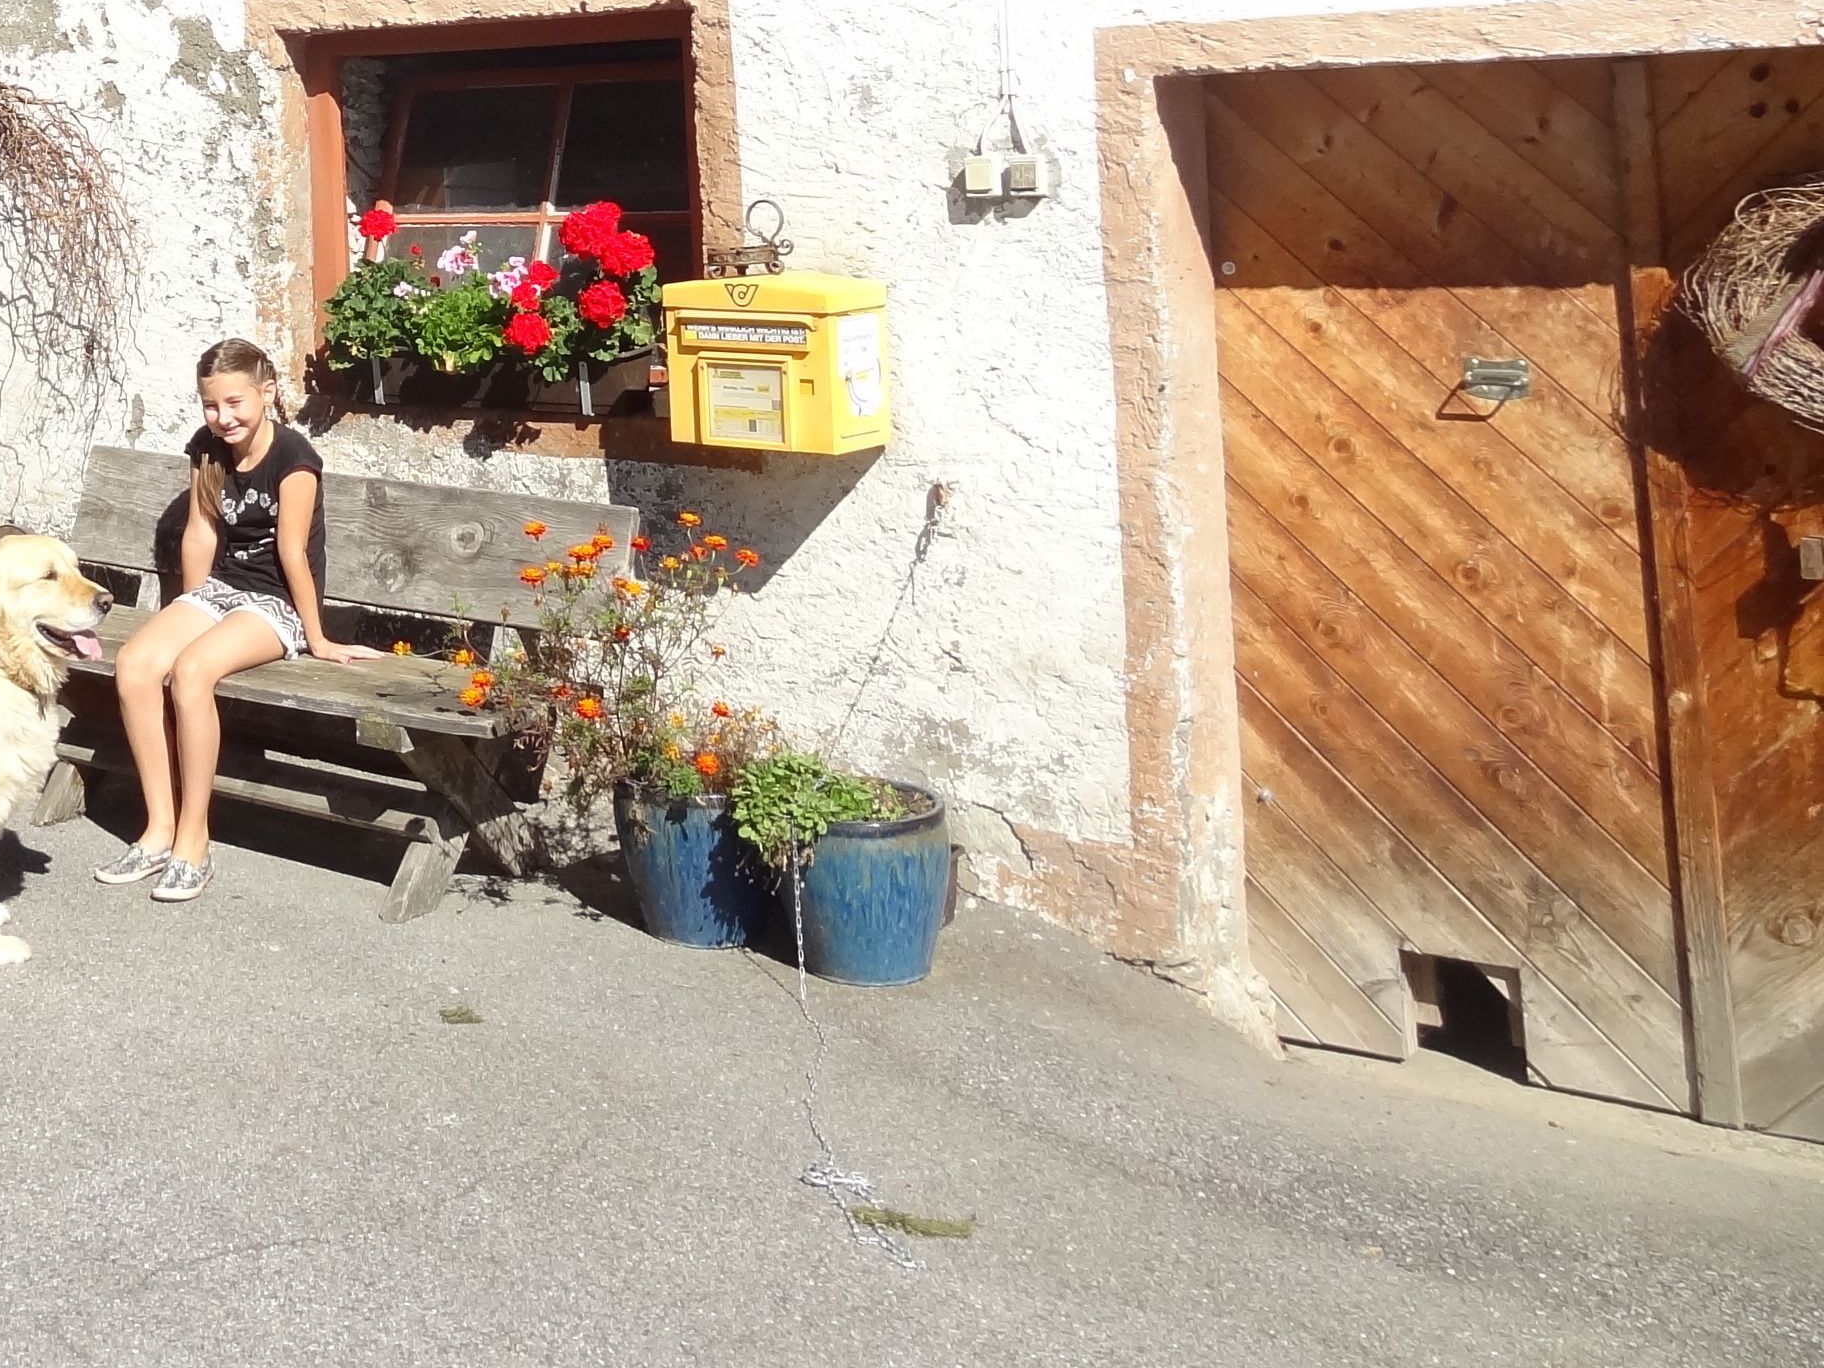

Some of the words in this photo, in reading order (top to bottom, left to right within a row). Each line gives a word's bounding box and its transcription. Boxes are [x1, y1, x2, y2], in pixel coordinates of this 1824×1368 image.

[698, 331, 720, 340] DANN
[721, 332, 748, 341] LIEBER
[749, 334, 763, 342] MIT
[764, 335, 781, 343] DER
[782, 335, 806, 344] POST.
